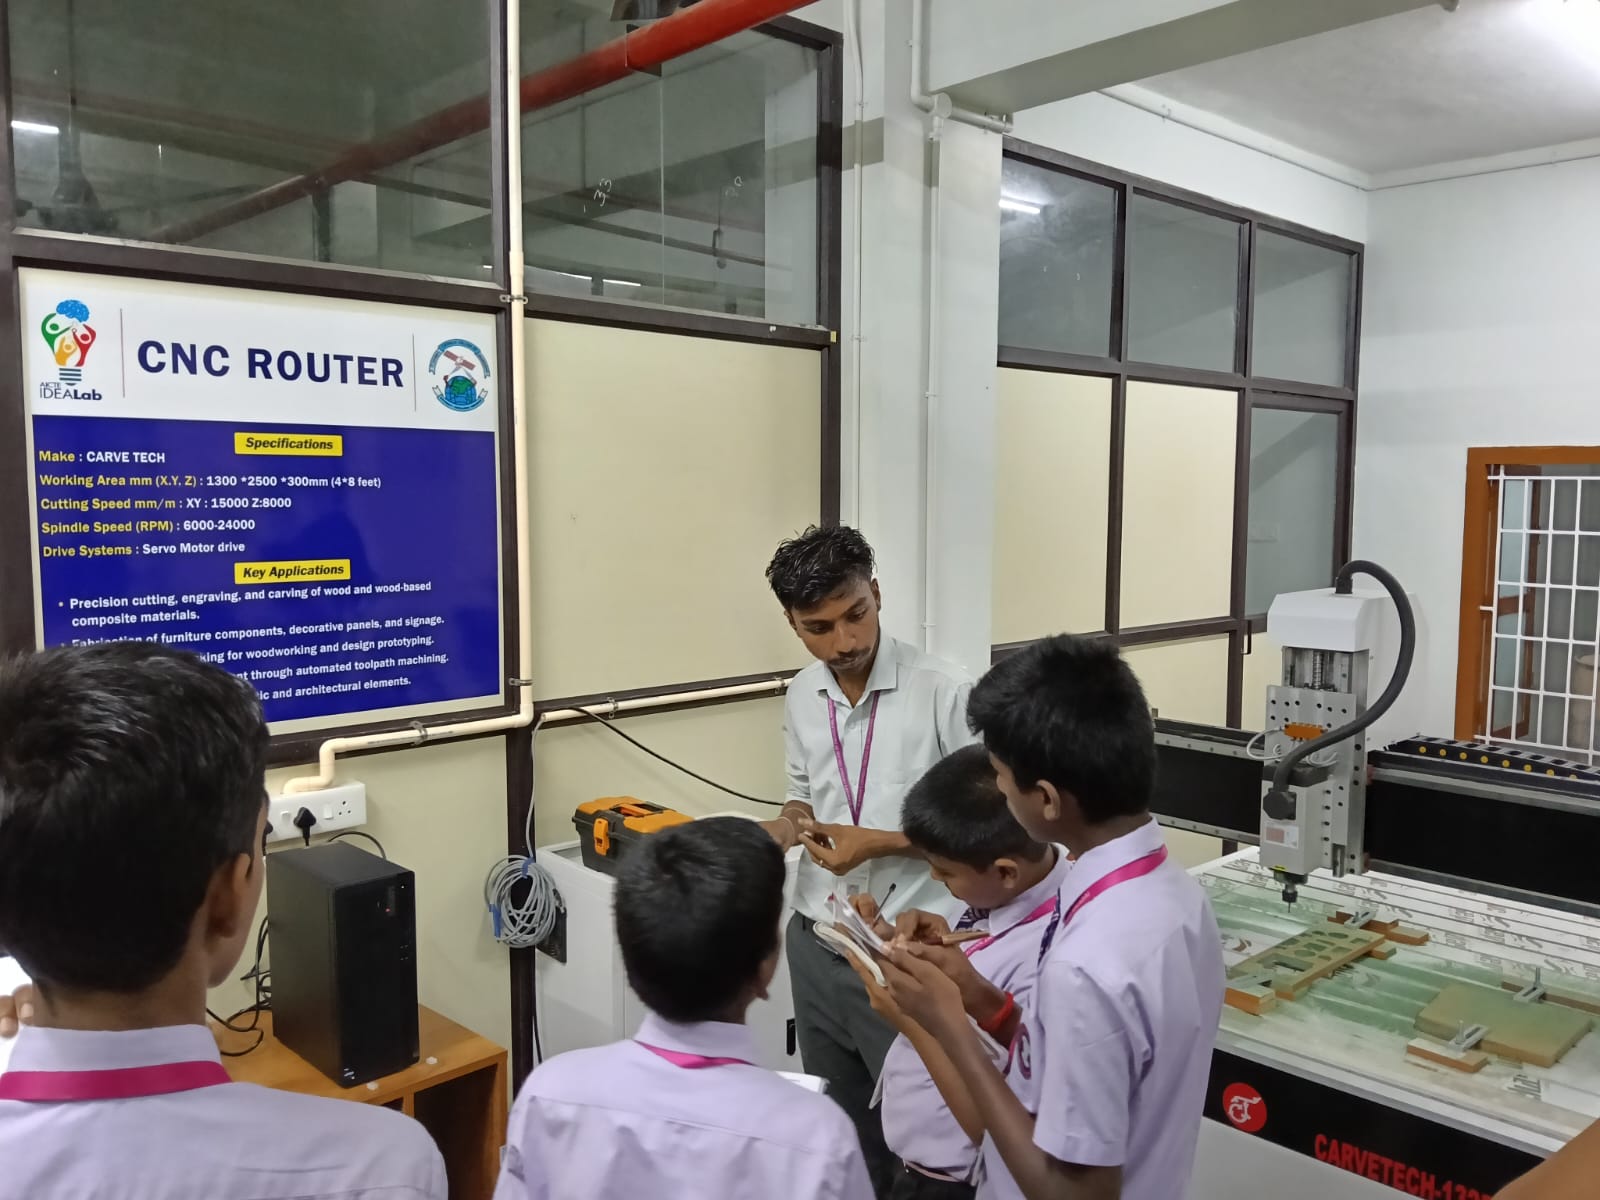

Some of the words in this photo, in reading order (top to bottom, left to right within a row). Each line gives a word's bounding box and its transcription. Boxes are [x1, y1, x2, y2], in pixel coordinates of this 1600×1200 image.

[137, 340, 230, 377] CNC
[247, 347, 404, 388] ROUTER
[40, 388, 103, 401] IDEALab
[245, 437, 334, 451] Specifications
[39, 451, 76, 463] Make
[86, 451, 130, 463] CARVE
[133, 451, 166, 463] TECH
[40, 475, 94, 488] Working
[97, 475, 126, 486] Area
[129, 477, 153, 486] mm
[184, 475, 197, 488] Z)
[206, 475, 238, 487] 1300
[357, 476, 382, 489] feet)
[40, 497, 89, 512] Cutting
[92, 498, 132, 512] Speed
[134, 498, 176, 511] mm/m
[186, 497, 202, 509] XY
[210, 497, 250, 509] 15000
[251, 497, 292, 509] Z:8000
[41, 521, 90, 536] Spindle
[93, 520, 132, 535] Speed
[135, 520, 174, 533] (RPM)
[183, 519, 256, 532] 6000-24000
[43, 546, 76, 558] Drive
[79, 545, 133, 558] Systems
[142, 543, 177, 555] Servo
[179, 542, 215, 554] Motor
[217, 541, 246, 553] drive
[243, 567, 266, 579] Key
[268, 564, 345, 579] Applications
[69, 597, 129, 610] Precision
[132, 593, 179, 607] cutting,
[181, 590, 242, 605] engraving,
[244, 589, 265, 600] and
[267, 587, 309, 600] carving
[310, 585, 322, 597] of
[323, 584, 351, 596] wood
[353, 582, 373, 595] and
[374, 580, 432, 593] wood-based
[71, 612, 138, 628] composite
[140, 609, 200, 623] materials.
[160, 630, 212, 644] furniture
[214, 626, 286, 641] components,
[288, 621, 344, 635] decorative
[346, 618, 382, 633] panels,
[384, 617, 403, 628] and
[404, 614, 445, 628] signage.
[226, 649, 243, 661] for
[245, 645, 318, 660] woodworking
[319, 641, 340, 653] and
[341, 639, 375, 652] design
[377, 635, 435, 650] prototyping.
[250, 666, 294, 681] through
[295, 661, 352, 676] automated
[354, 657, 396, 671] toolpath
[397, 653, 449, 667] machining.
[272, 687, 293, 700] and
[294, 680, 362, 697] architectural
[363, 676, 412, 690] elements.
